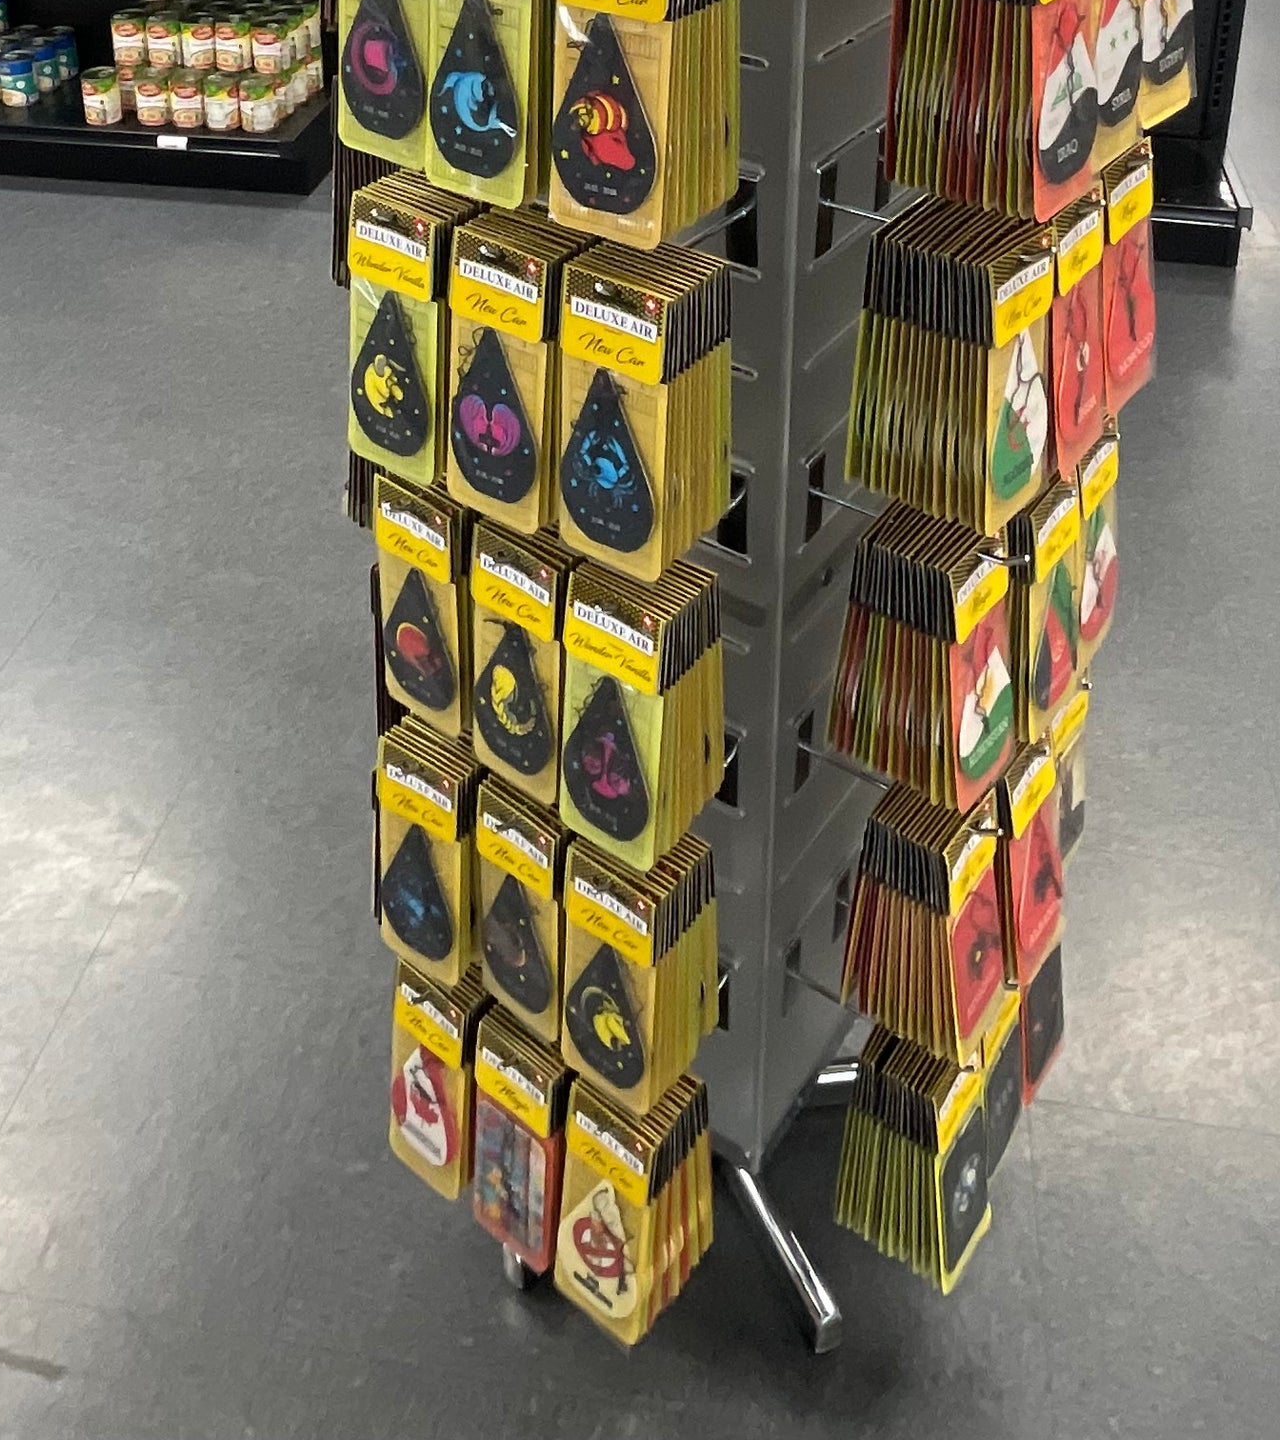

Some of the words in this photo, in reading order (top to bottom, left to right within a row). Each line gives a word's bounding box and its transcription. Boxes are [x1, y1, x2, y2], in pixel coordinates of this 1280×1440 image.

[358, 223, 404, 252] DELUXE
[404, 241, 424, 259] AIR
[463, 261, 512, 290] DELUXE
[512, 281, 535, 301] AIR
[465, 292, 499, 317] New
[500, 304, 528, 327] Car
[574, 299, 628, 329] DELUXE
[628, 319, 654, 340] AIR
[578, 332, 613, 357] New
[615, 345, 645, 368] Car
[421, 527, 442, 548] AIR
[483, 556, 527, 590] DELUXE
[527, 580, 547, 602] AIR
[577, 606, 627, 640] DELUXE
[627, 630, 650, 653] AIR
